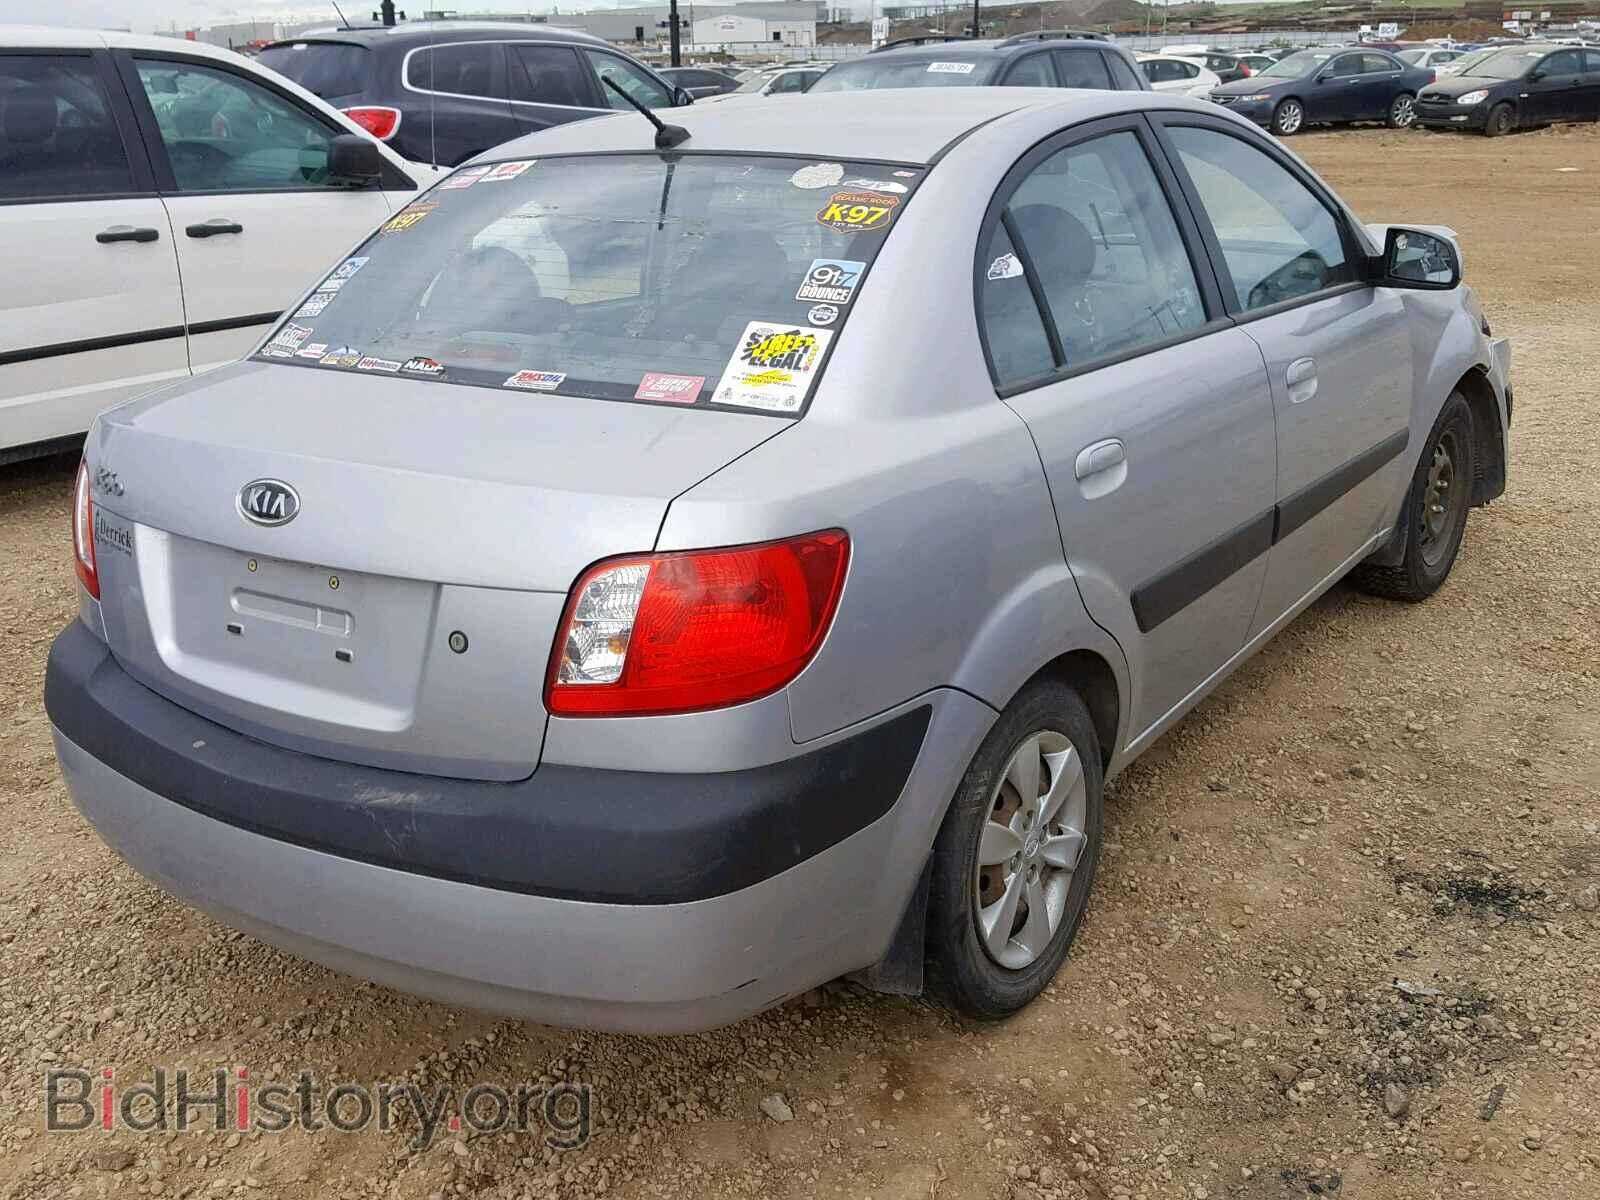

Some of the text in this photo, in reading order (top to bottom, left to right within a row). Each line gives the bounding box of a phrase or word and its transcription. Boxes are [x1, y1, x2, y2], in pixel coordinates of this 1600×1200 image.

[800, 286, 849, 300] BOUNCE
[248, 485, 287, 517] KIA
[100, 517, 132, 549] Derrick
